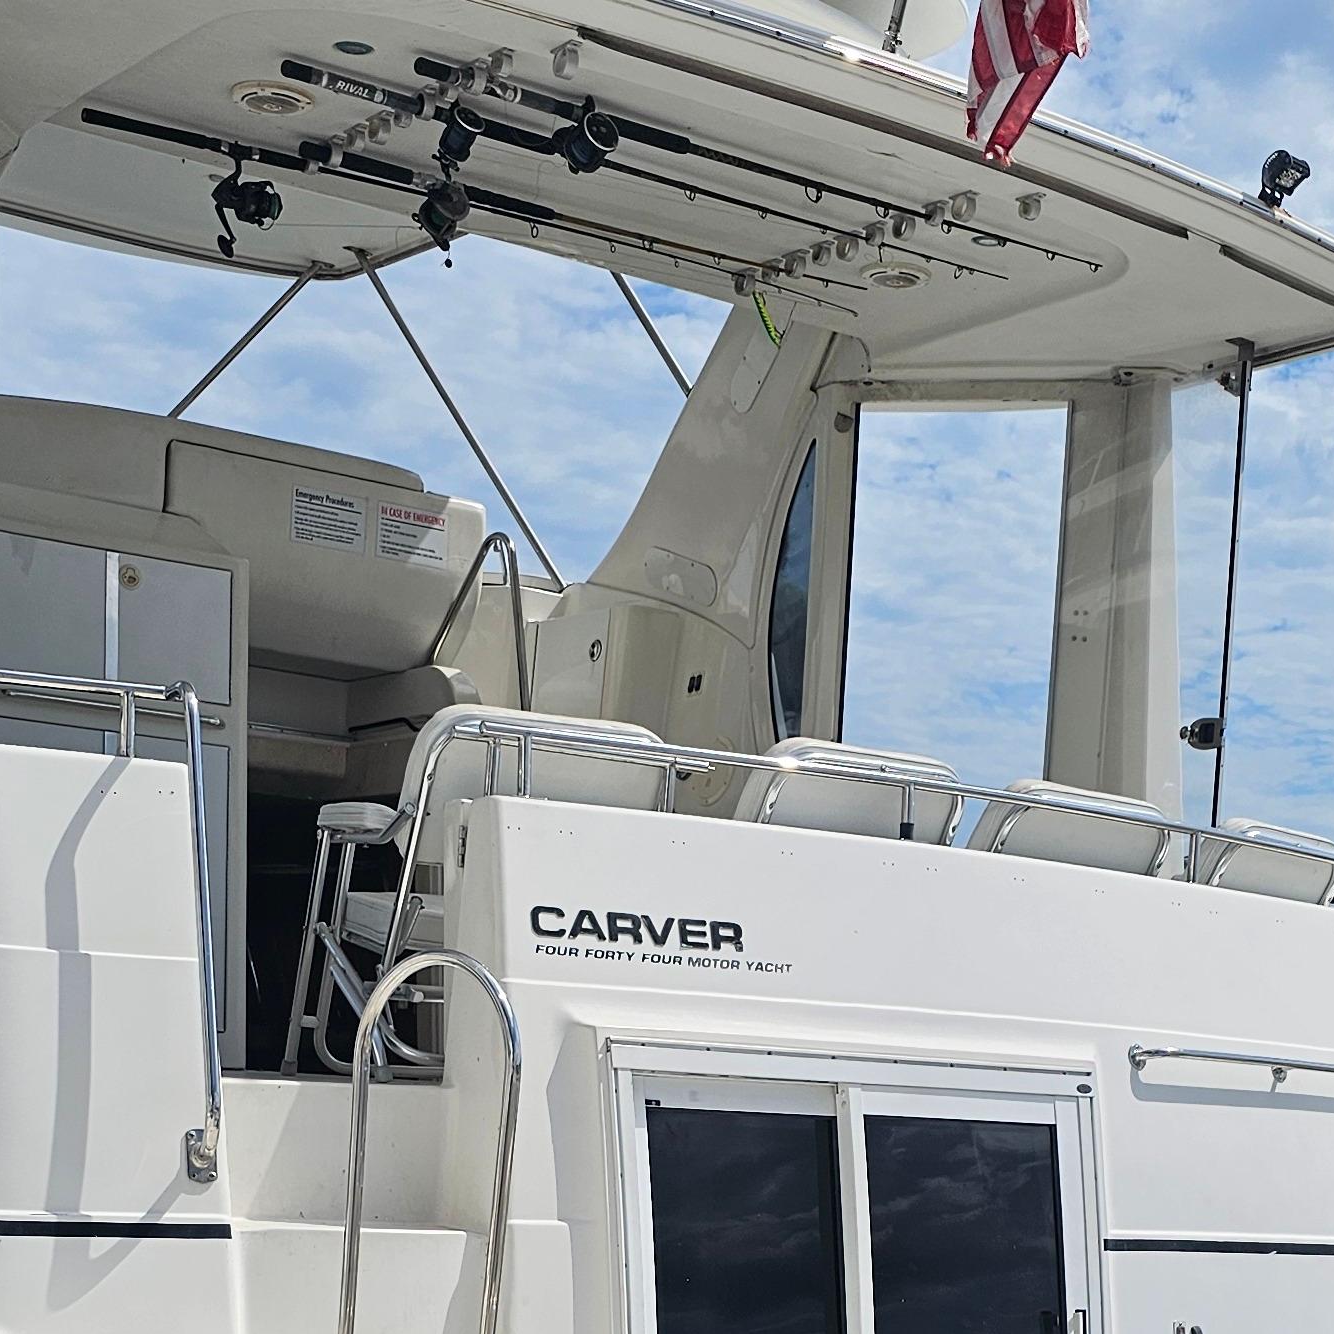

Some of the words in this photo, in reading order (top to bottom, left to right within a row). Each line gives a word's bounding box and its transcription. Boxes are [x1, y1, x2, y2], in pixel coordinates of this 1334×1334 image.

[336, 80, 370, 98] RIVAL
[295, 489, 324, 503] Emergency
[325, 494, 355, 508] Procedures
[387, 507, 403, 519] CASE
[404, 510, 412, 520] OF
[413, 512, 446, 527] EMERGENCY
[530, 905, 744, 952] CARVER
[535, 944, 579, 958] FOUR
[584, 949, 635, 963] FORTY
[641, 952, 683, 966] FOUR
[687, 956, 740, 970] MOTOR
[746, 960, 793, 974] YACHT
